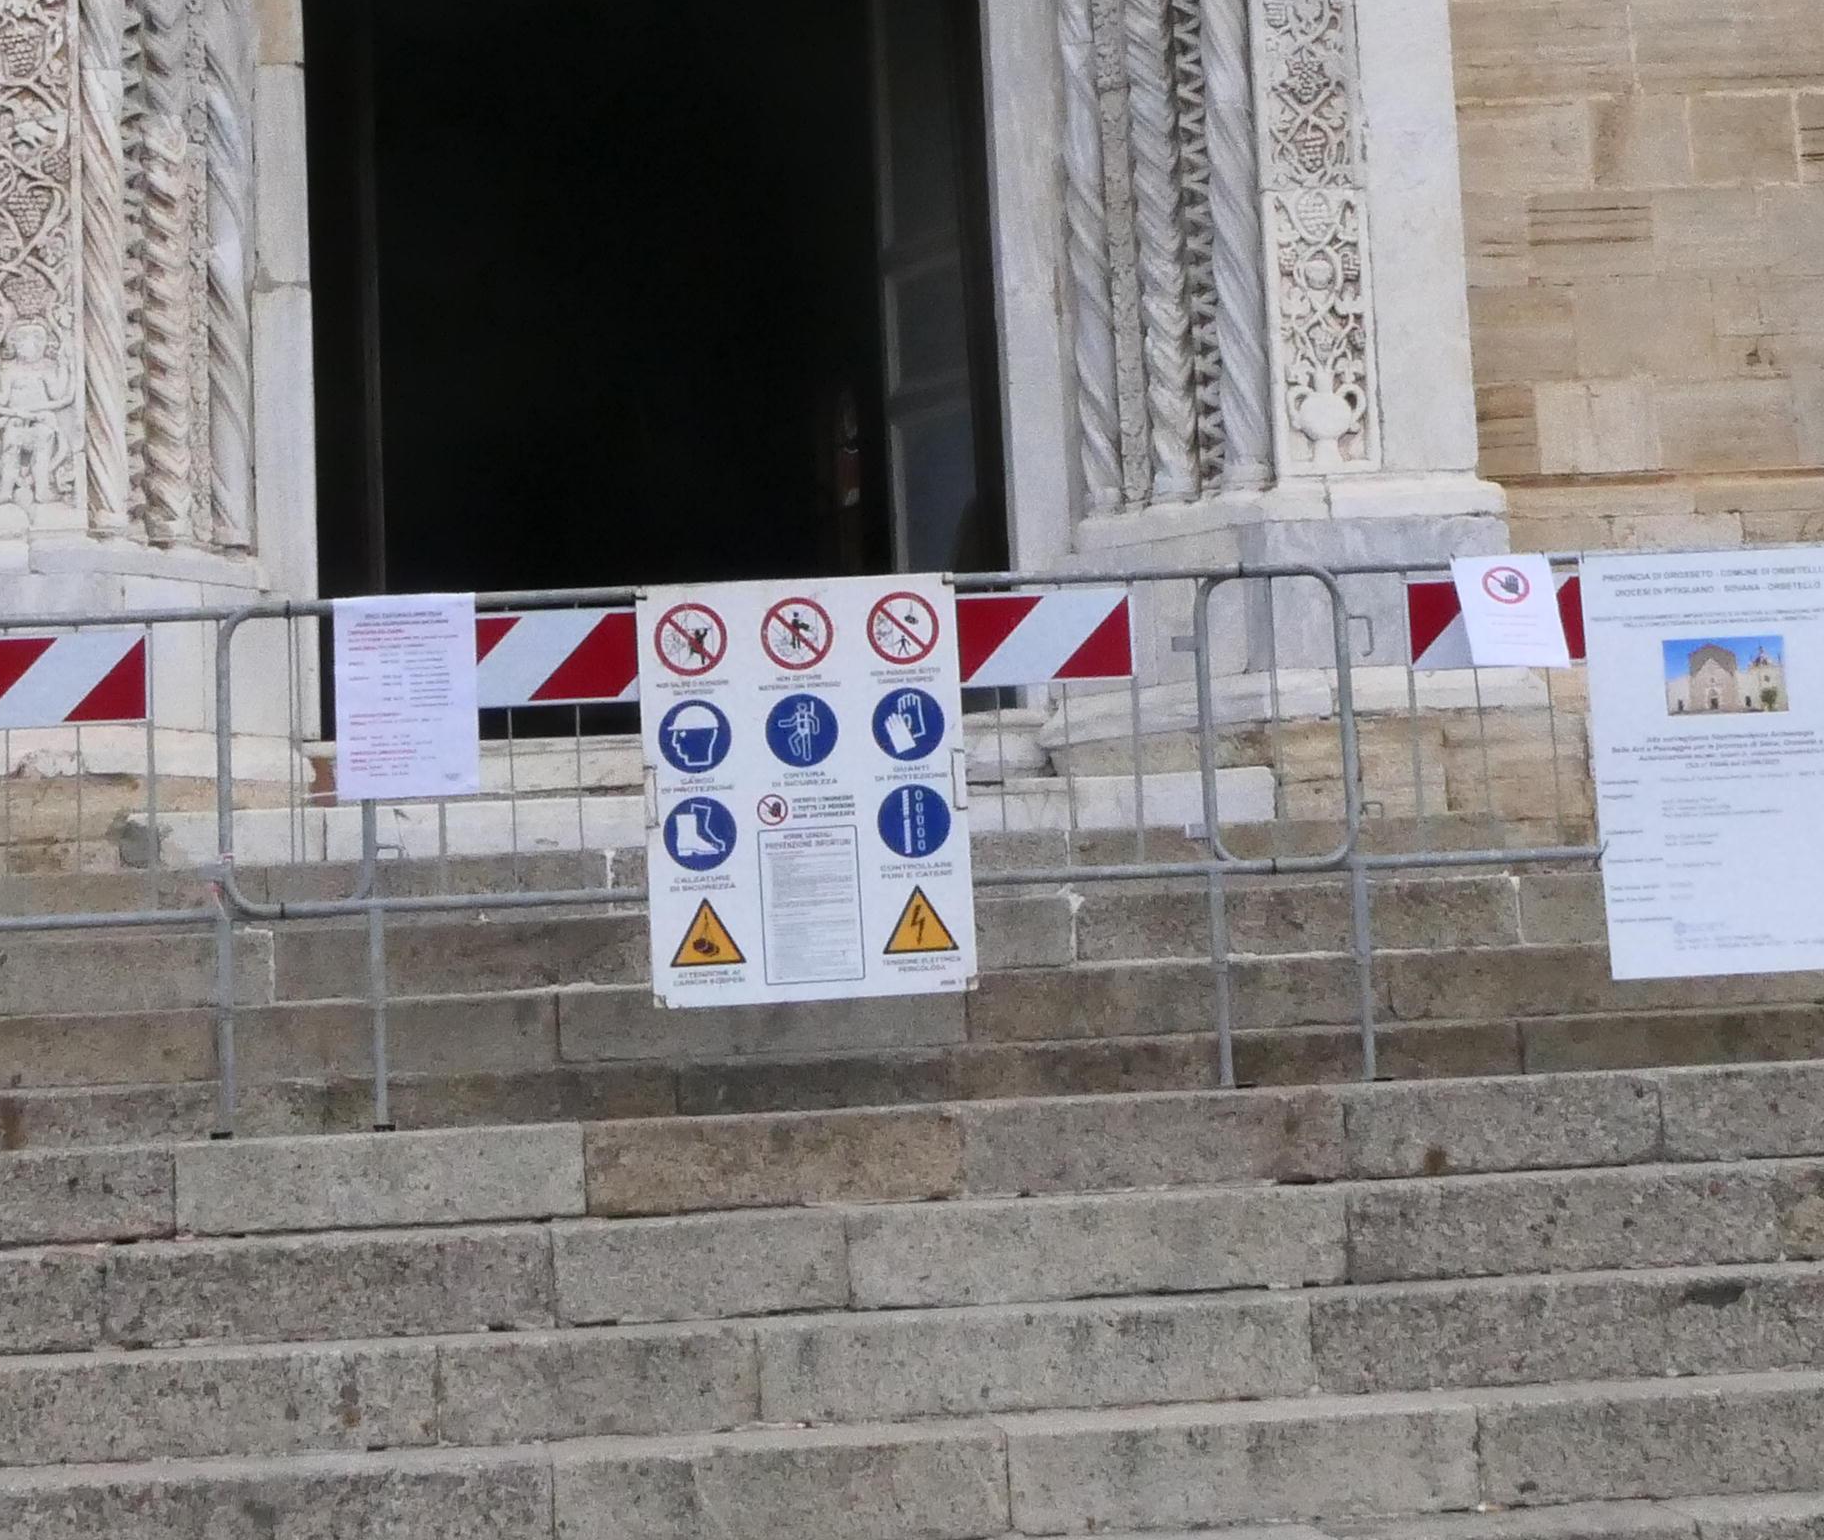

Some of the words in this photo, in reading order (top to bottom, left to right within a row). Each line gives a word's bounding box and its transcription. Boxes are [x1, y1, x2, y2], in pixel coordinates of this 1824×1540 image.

[1602, 572, 1651, 581] PROVINCIA
[1652, 571, 1661, 580] DI
[1663, 570, 1713, 580] GROSSETO
[1720, 568, 1758, 577] COMUNE
[1761, 567, 1770, 575] DI
[1615, 587, 1651, 597] DIOCESI
[1664, 585, 1714, 595] PITIGLIANO
[879, 861, 953, 872] CONTROLLARE
[674, 874, 731, 884] CALZATURE
